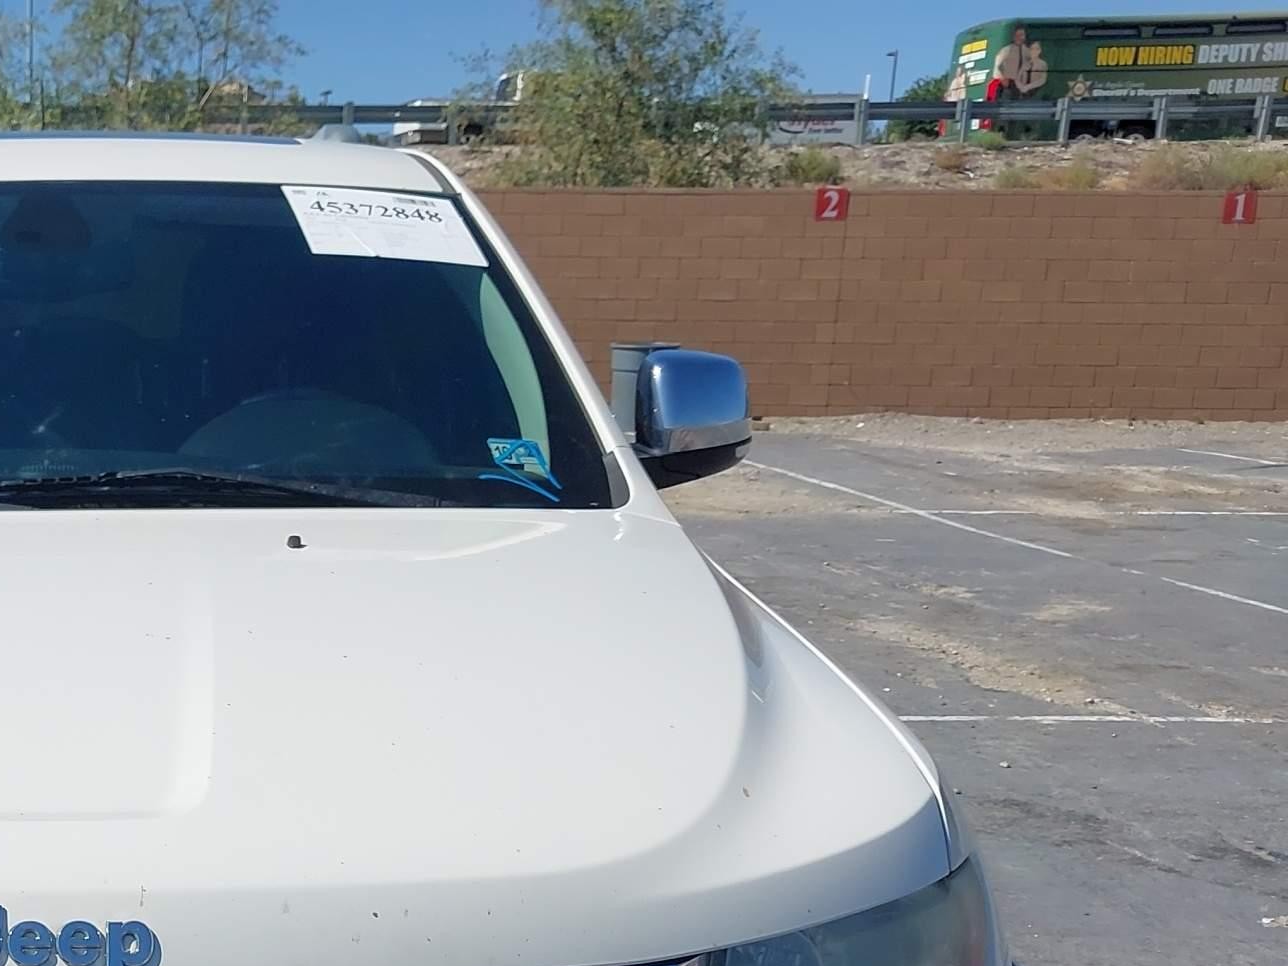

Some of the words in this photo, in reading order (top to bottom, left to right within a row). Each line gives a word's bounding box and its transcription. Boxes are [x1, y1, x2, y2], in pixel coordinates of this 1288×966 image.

[1096, 47, 1136, 66] NOW
[1137, 45, 1194, 65] HIRING
[1198, 43, 1261, 63] DEPUTY
[1207, 79, 1234, 94] ONE
[1235, 77, 1279, 93] BADGE
[310, 201, 442, 223] 45372848
[822, 191, 839, 217] 2
[1232, 193, 1246, 220] 1
